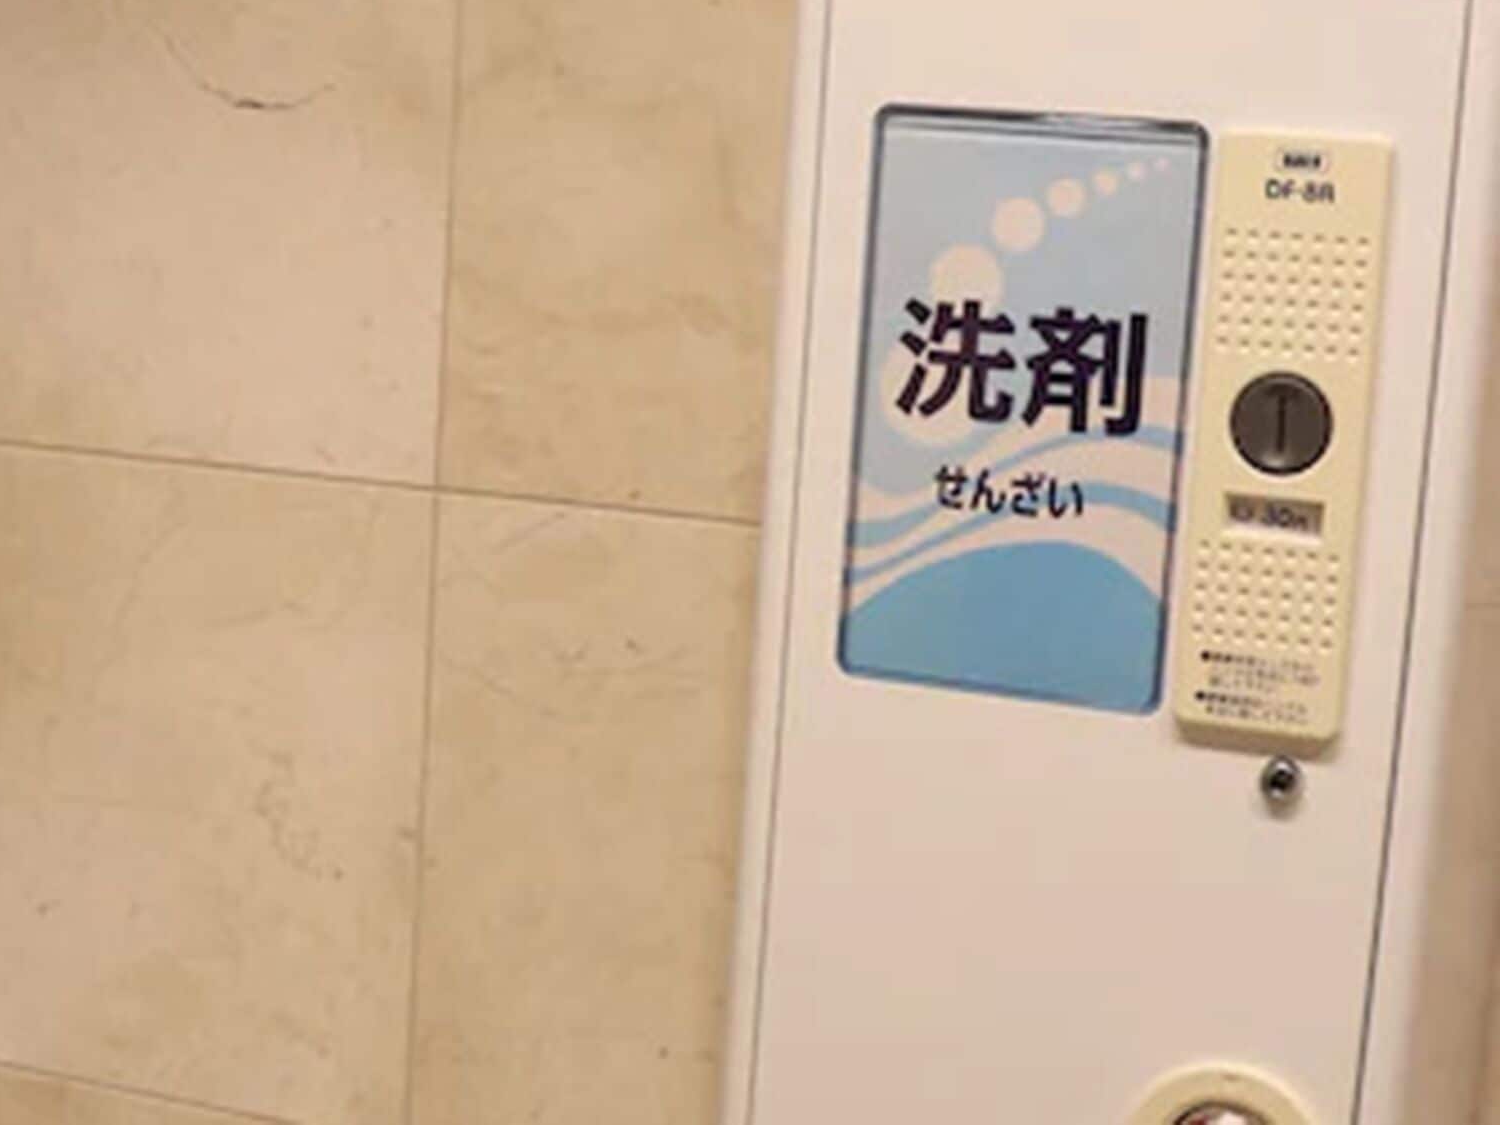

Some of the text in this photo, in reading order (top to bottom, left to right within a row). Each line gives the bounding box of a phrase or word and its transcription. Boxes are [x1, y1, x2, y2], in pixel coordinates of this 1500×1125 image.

[896, 298, 1148, 437] 洗剤
[934, 466, 1085, 520] せんざい
